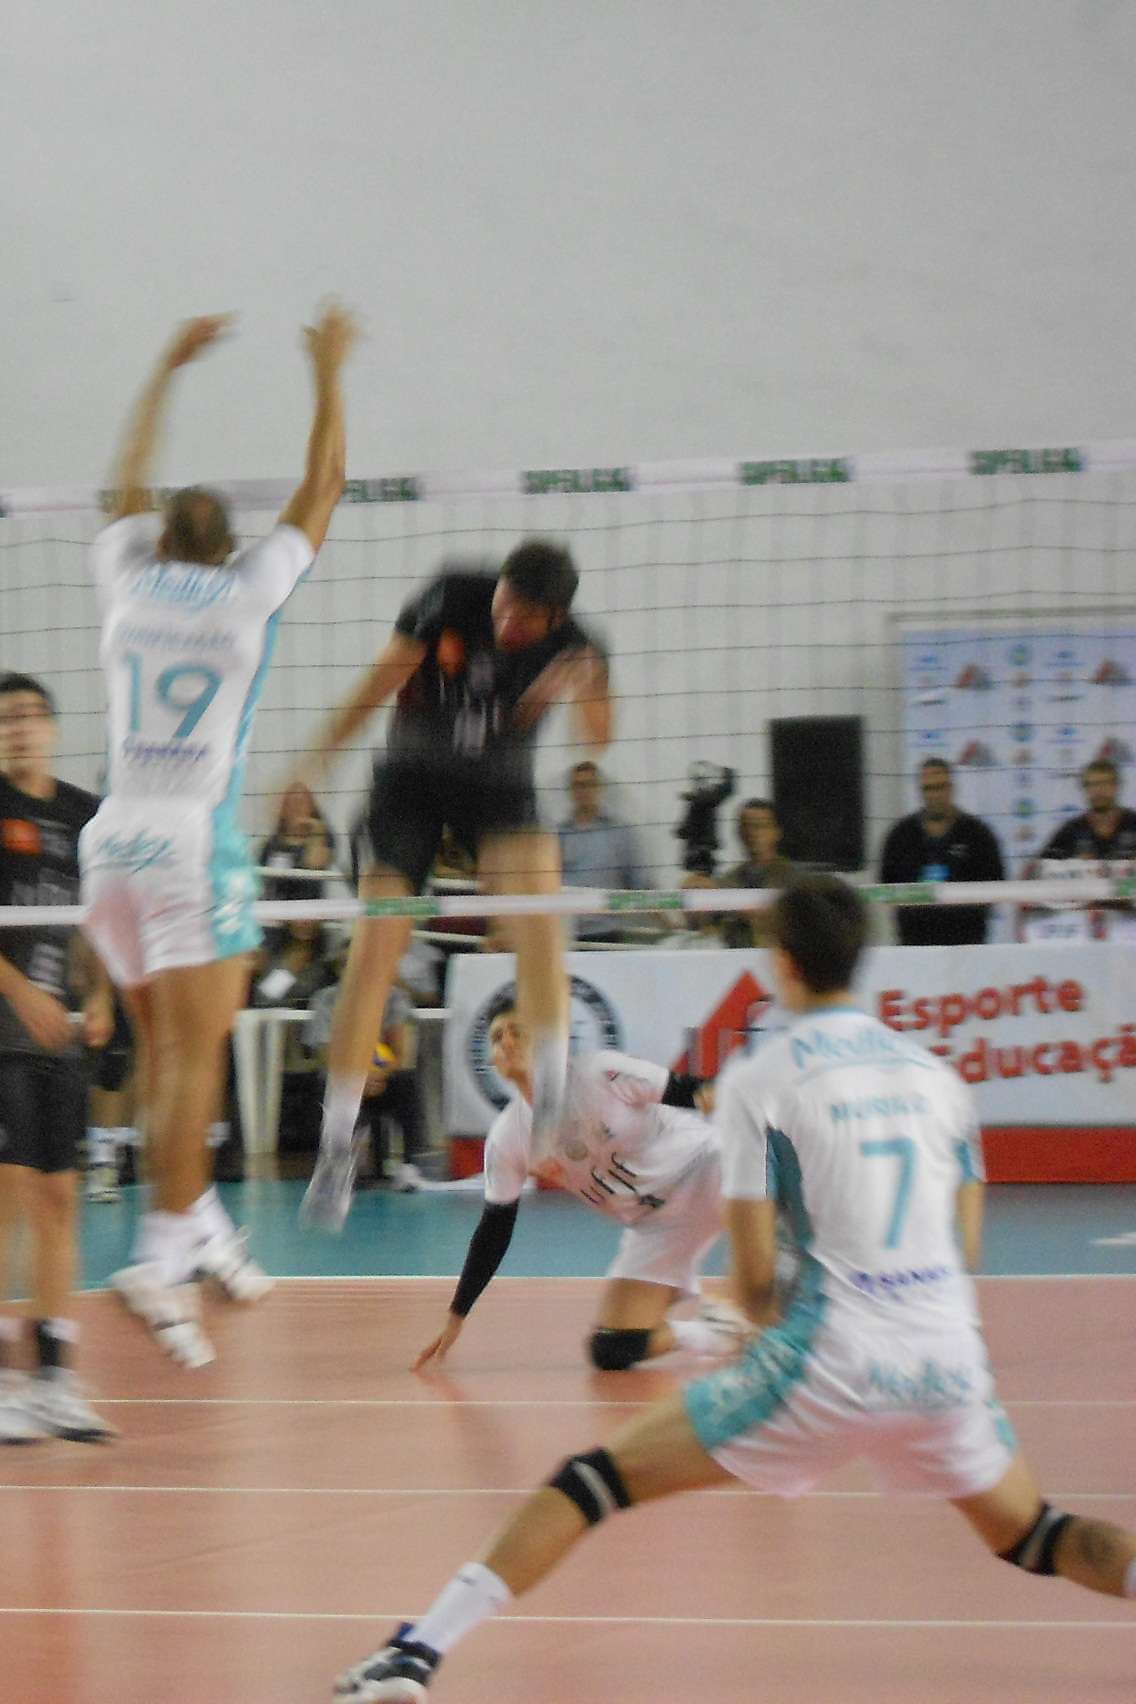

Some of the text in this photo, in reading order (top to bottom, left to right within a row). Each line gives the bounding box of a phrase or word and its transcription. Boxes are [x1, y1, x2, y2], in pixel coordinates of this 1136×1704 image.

[123, 651, 223, 739] 19
[876, 976, 1085, 1038] Esporte
[860, 1137, 920, 1250] 7
